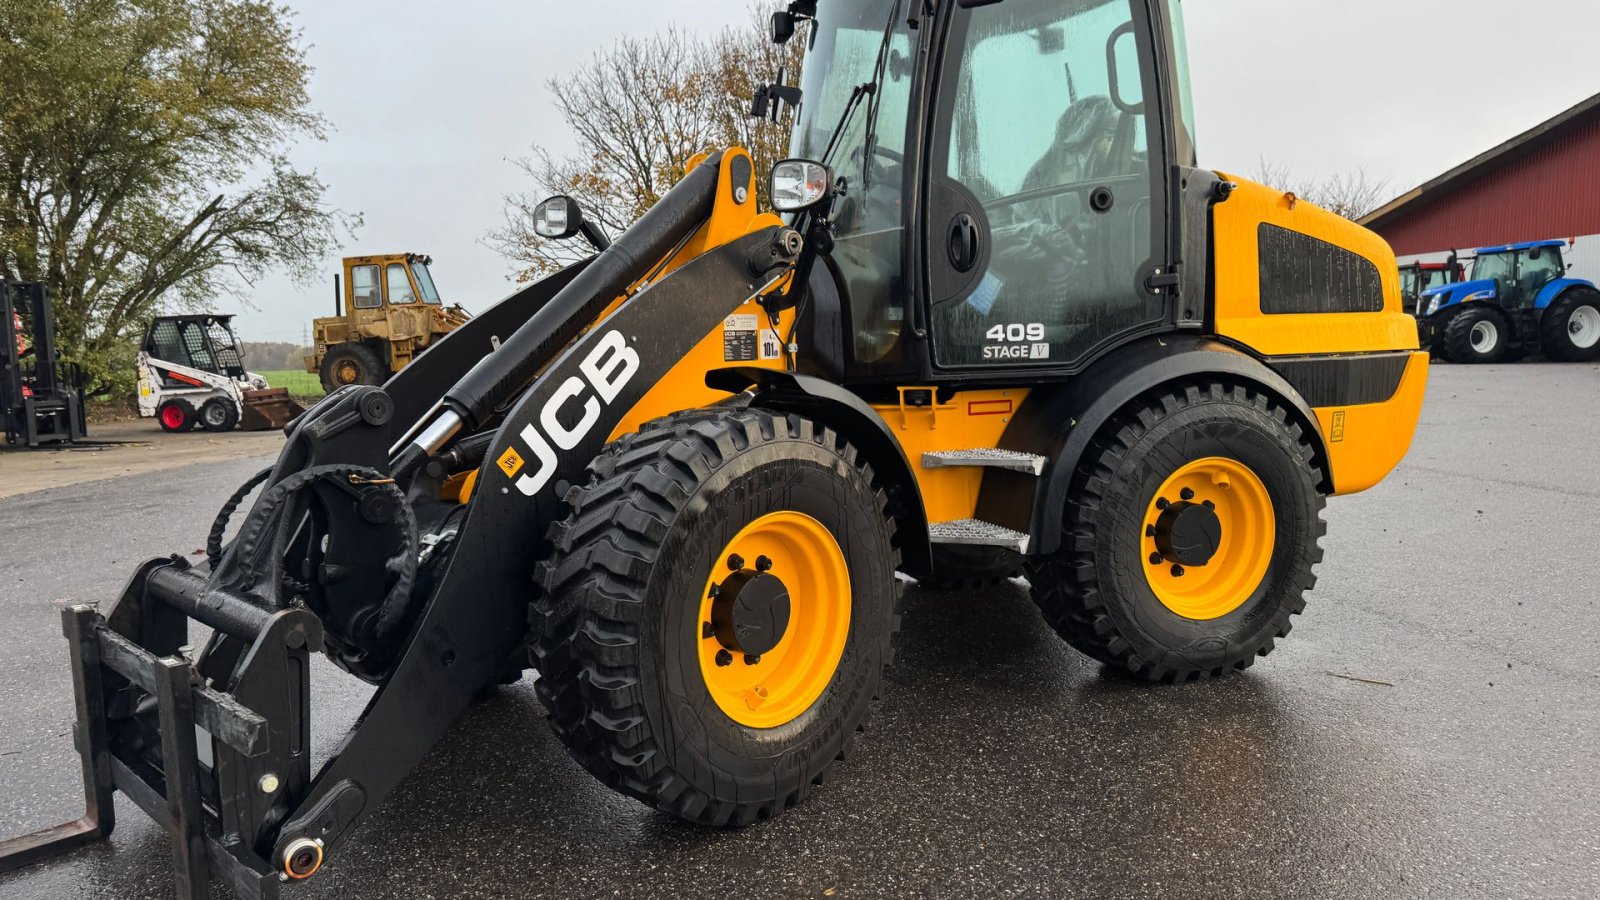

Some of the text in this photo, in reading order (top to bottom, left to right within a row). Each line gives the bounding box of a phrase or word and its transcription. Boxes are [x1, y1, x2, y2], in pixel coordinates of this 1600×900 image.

[986, 323, 1045, 342] 409
[763, 342, 774, 357] 101
[983, 344, 1047, 358] STAGE V
[515, 330, 640, 496] JCB
[504, 455, 517, 469] JCB
